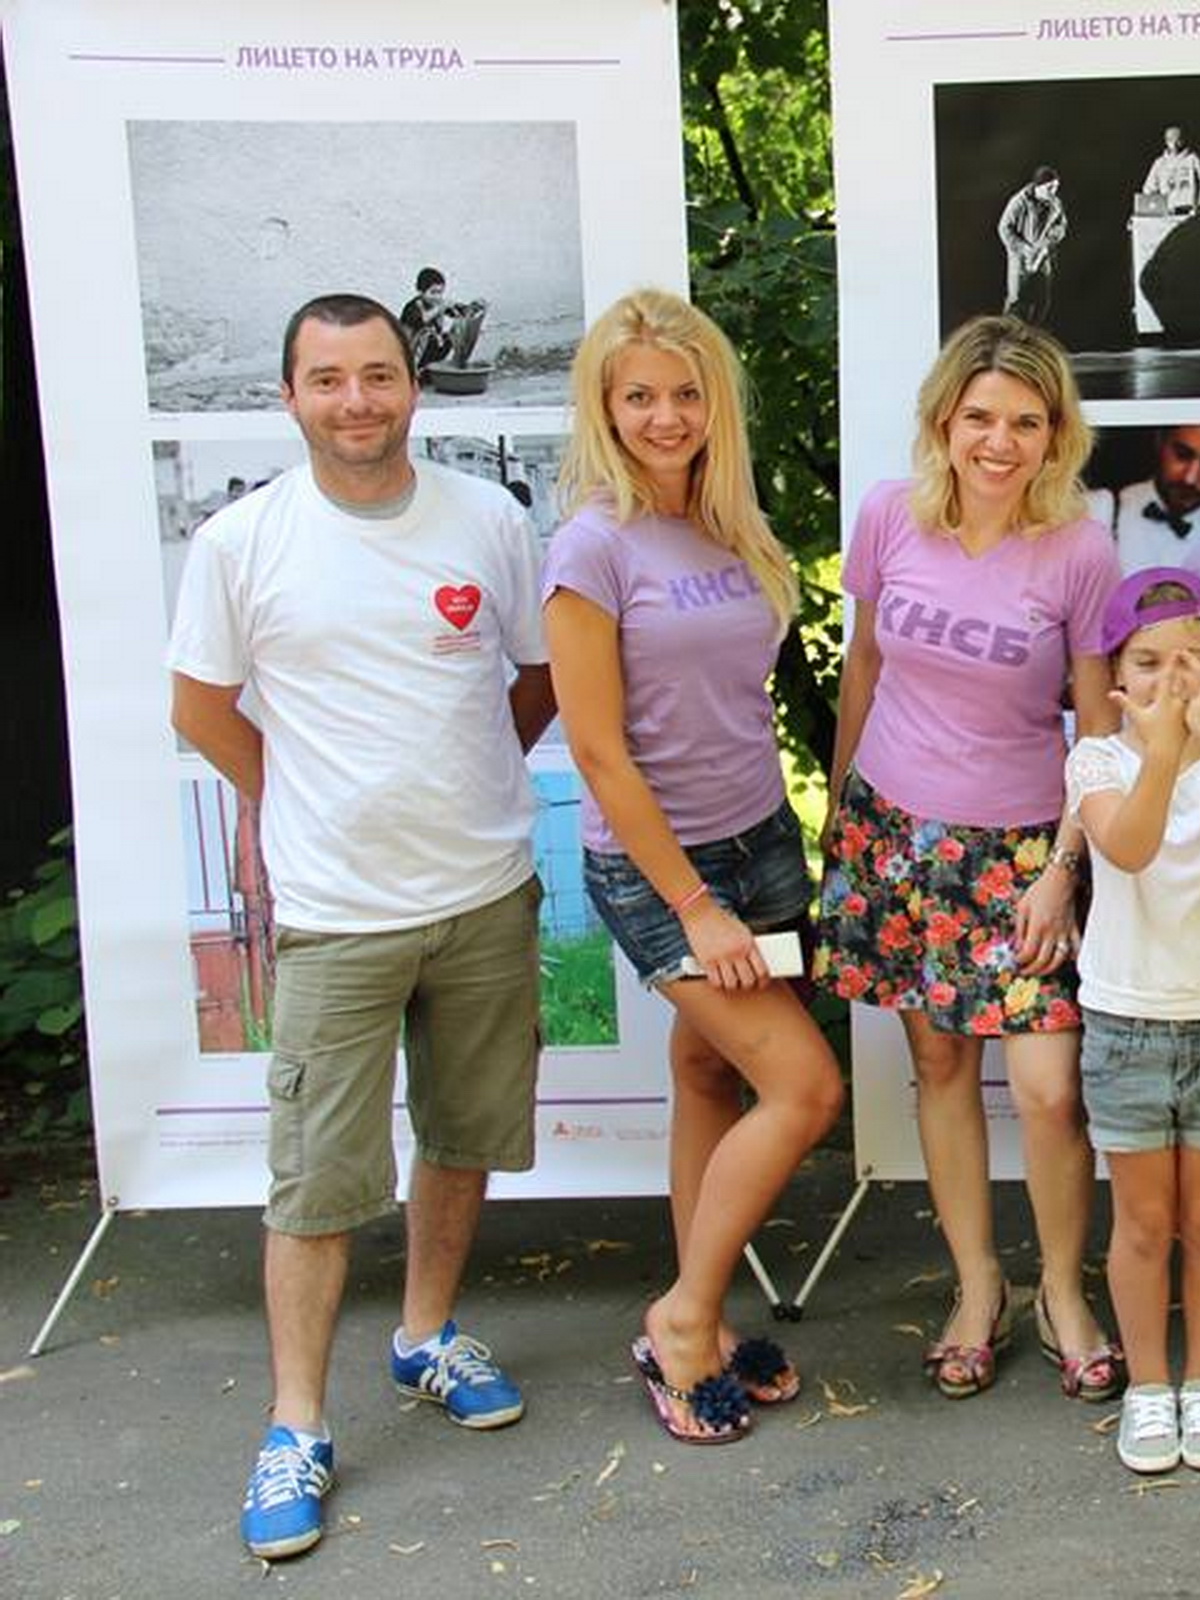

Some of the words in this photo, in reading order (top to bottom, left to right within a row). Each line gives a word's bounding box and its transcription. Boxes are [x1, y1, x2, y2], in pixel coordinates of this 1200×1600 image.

[1036, 16, 1133, 40] ЛИЦЕТО
[1140, 15, 1172, 35] НА
[236, 46, 338, 70] ЛИЦЕТО
[345, 47, 378, 68] НА
[382, 47, 464, 71] ТРУДА
[881, 590, 1031, 668] КНСБ
